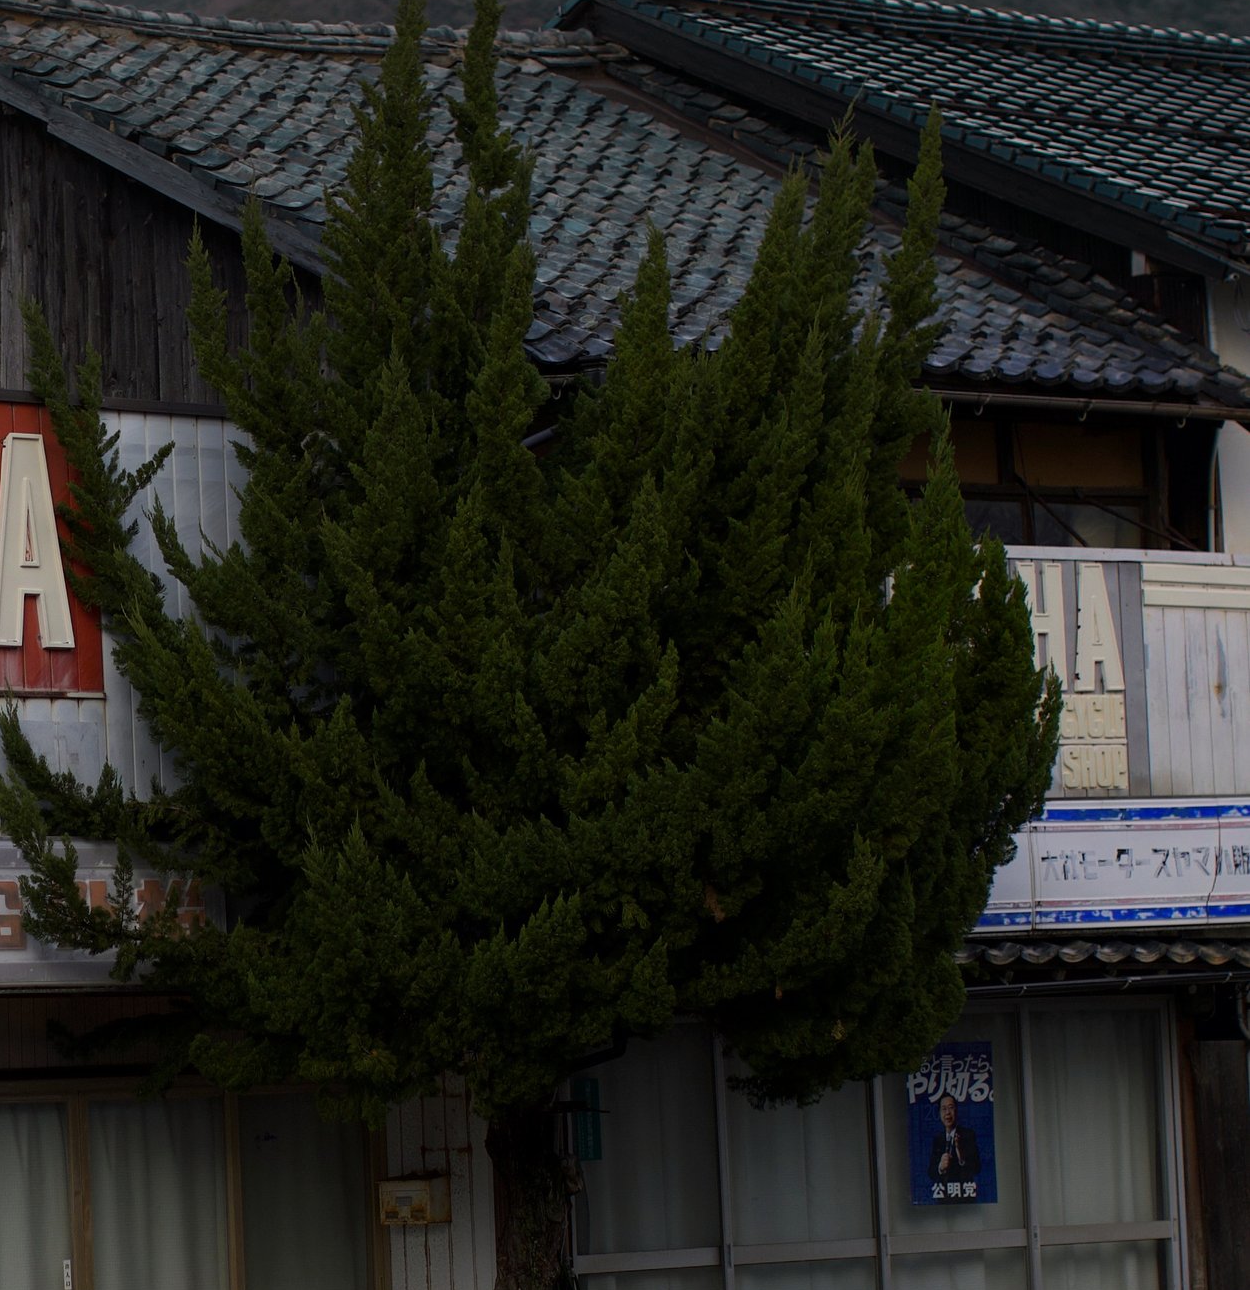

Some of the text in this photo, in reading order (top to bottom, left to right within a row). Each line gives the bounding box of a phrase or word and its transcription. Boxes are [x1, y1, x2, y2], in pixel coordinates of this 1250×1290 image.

[1062, 744, 1127, 789] SHOP
[931, 1181, 977, 1199] 公明党
